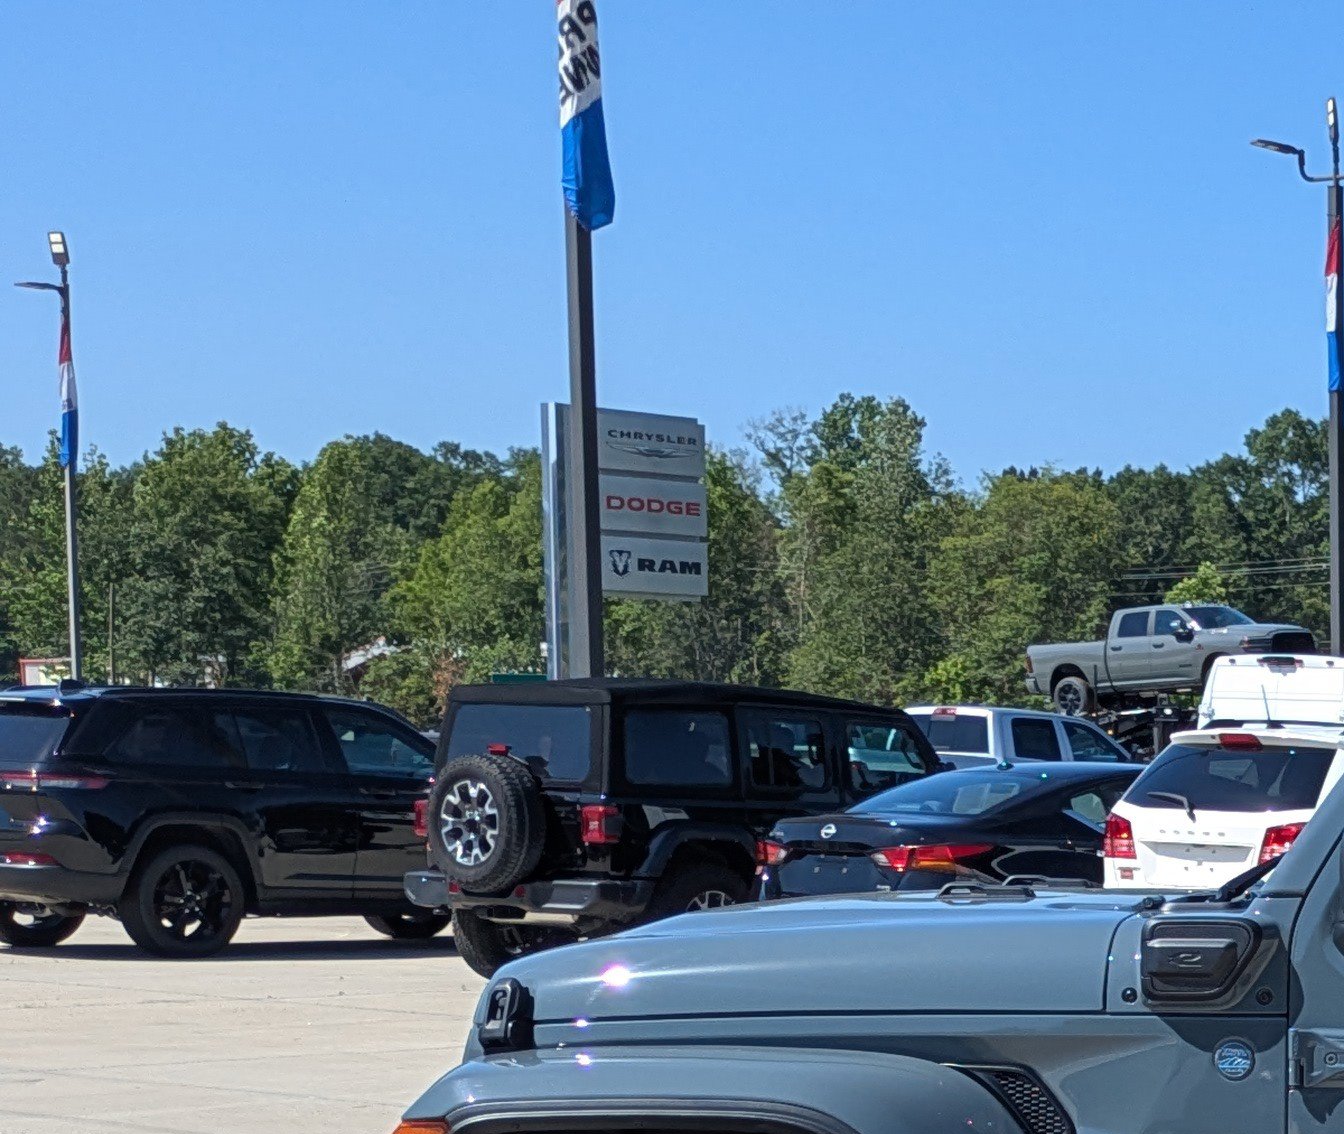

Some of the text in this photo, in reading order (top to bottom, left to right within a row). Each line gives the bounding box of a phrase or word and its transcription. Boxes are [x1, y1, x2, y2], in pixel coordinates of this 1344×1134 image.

[607, 429, 697, 446] CHRYSLER
[606, 495, 701, 517] DODGE
[638, 558, 702, 575] RAM
